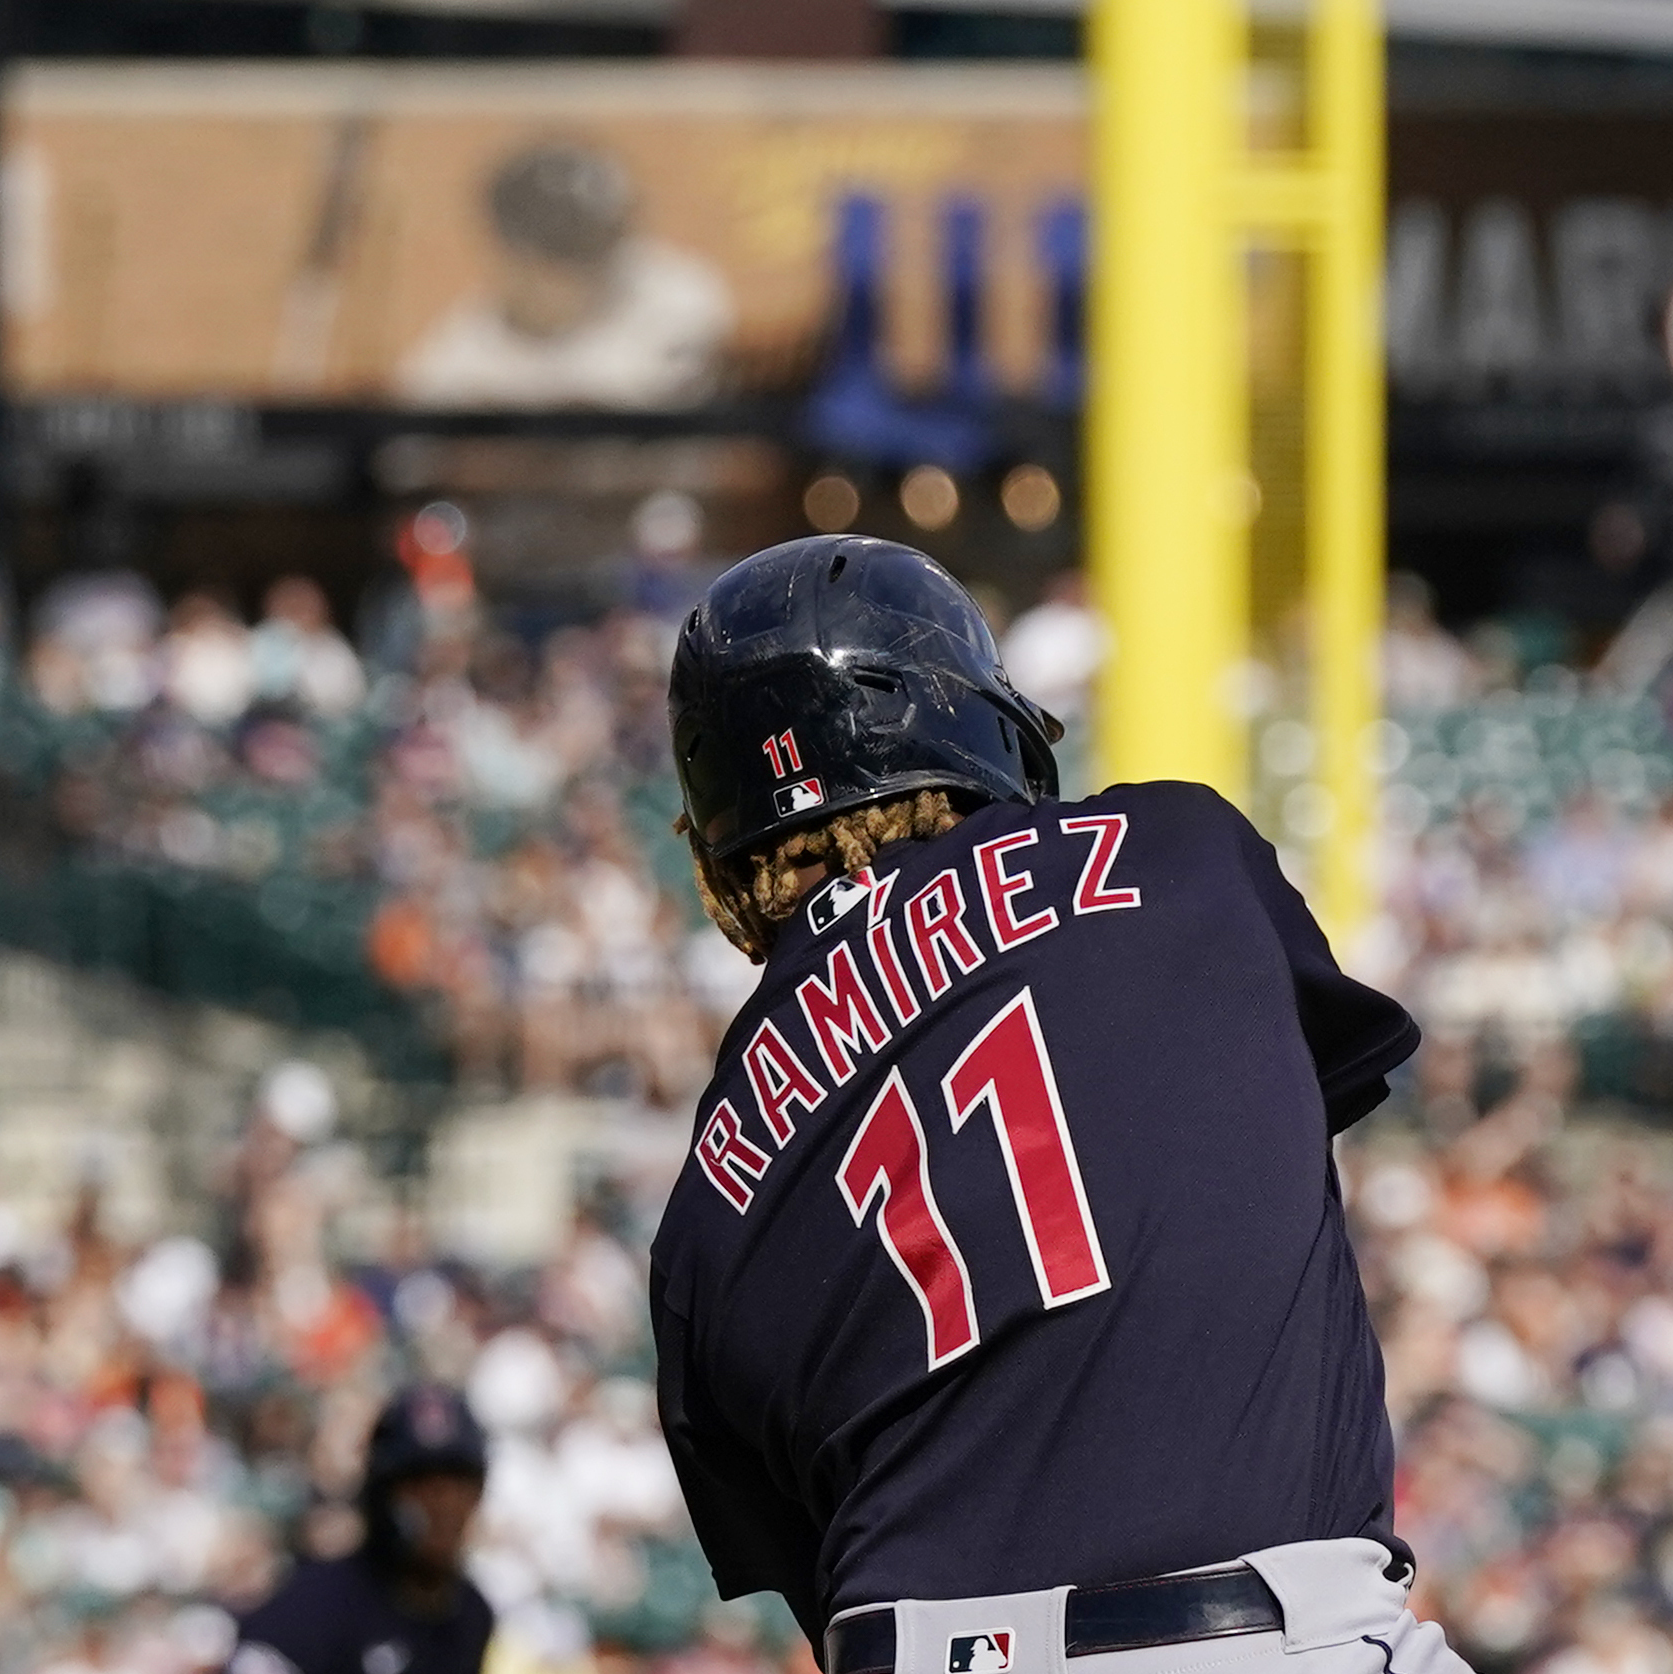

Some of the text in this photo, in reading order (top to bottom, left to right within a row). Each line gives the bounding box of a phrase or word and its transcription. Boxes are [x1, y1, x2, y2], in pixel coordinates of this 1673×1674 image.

[762, 727, 803, 779] 11
[695, 813, 1142, 1215] RAMÍREZ
[836, 986, 1112, 1372] 11
